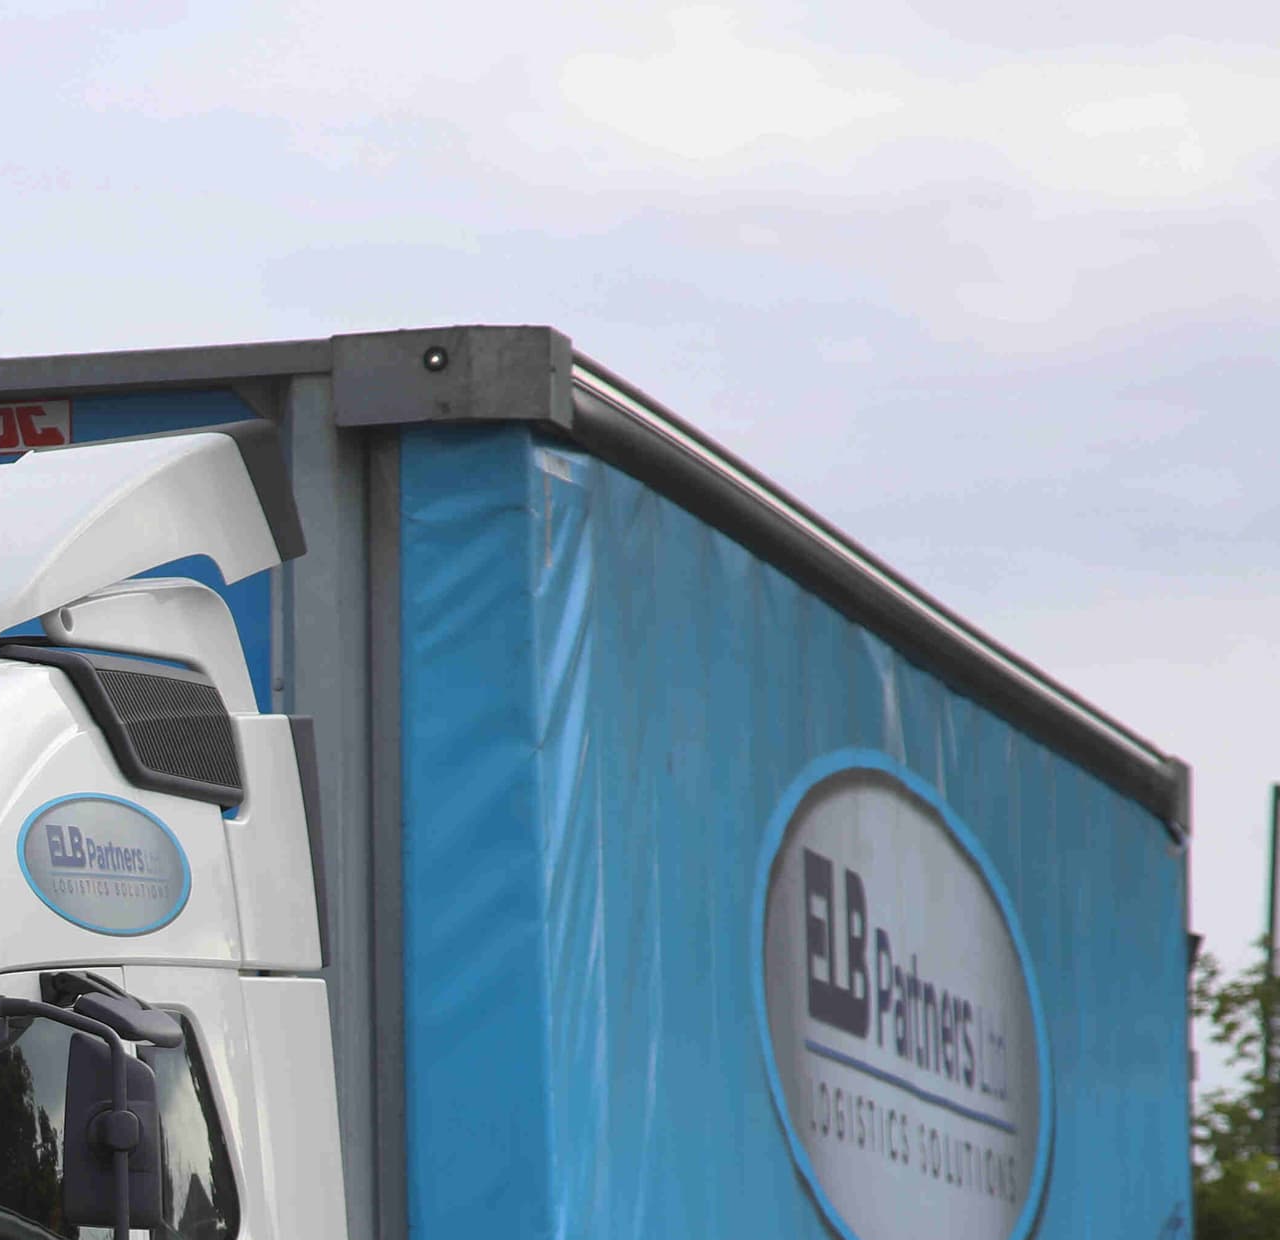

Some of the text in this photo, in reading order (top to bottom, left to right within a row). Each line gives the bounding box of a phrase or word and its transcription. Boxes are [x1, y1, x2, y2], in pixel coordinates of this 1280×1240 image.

[46, 824, 87, 868] ELB
[85, 838, 145, 874] Partners
[804, 848, 869, 1040] ELB
[875, 926, 977, 1089] Partners
[808, 1080, 1017, 1204] LOGISTICS SOLUTIONS
